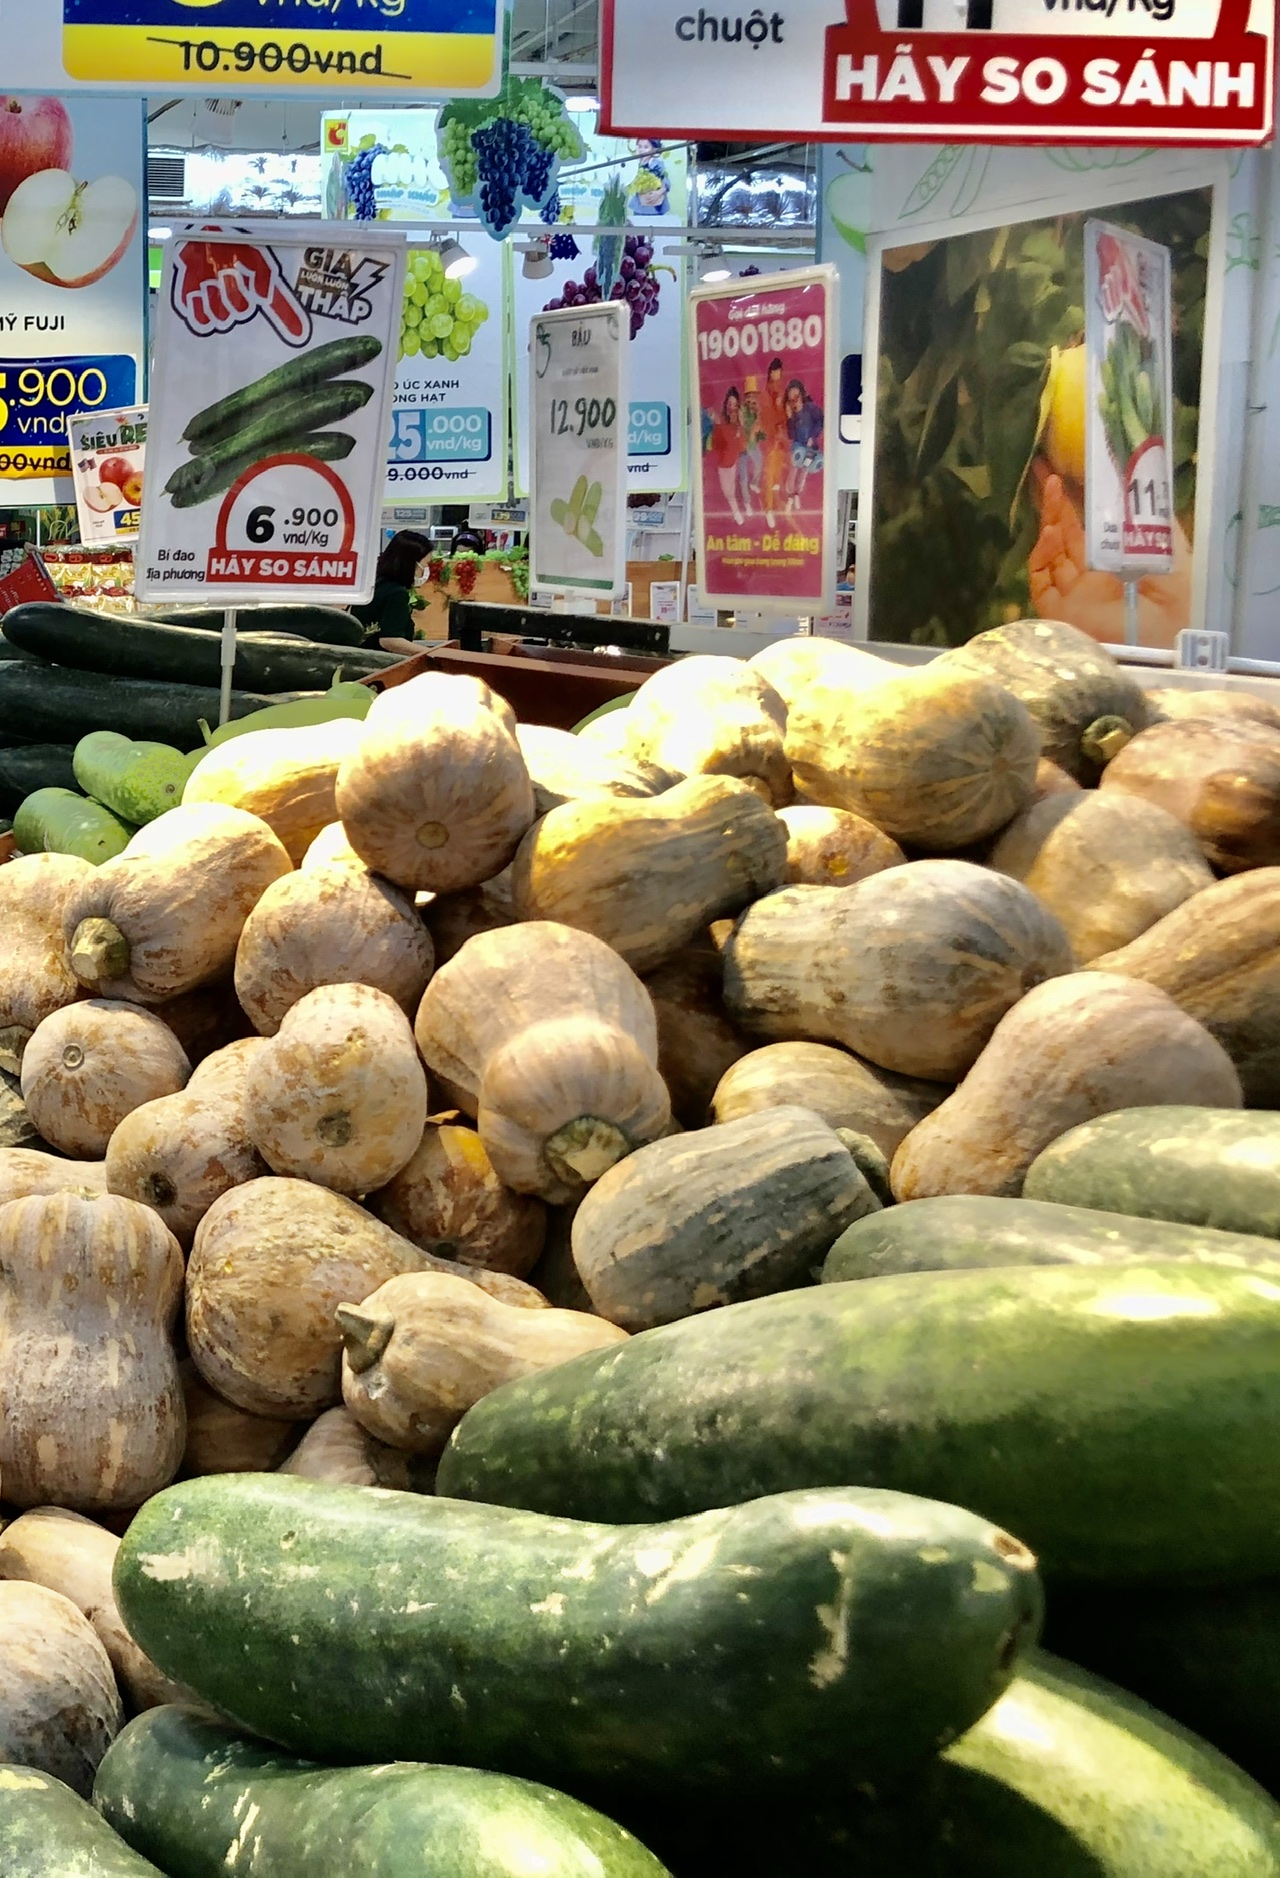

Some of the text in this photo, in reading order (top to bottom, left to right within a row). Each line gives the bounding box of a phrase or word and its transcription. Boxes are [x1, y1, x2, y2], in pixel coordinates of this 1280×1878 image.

[675, 9, 784, 51] chuột
[179, 42, 382, 75] 10.900vnd
[835, 43, 1255, 108] HÃY SO SÁNH
[301, 270, 350, 291] LUÔN LUÔN
[23, 315, 65, 331] FUJI
[698, 314, 823, 361] 19001880
[403, 378, 460, 390] ÚC XANH
[420, 392, 447, 405] HẠT
[17, 409, 80, 434] vnd/
[549, 397, 617, 437] 12.900
[80, 431, 118, 452] SIÊU
[426, 435, 482, 452] vnd/kg
[245, 506, 275, 544] 6
[283, 529, 329, 547] vnd/Kg
[706, 534, 724, 551] An
[726, 533, 752, 552] tâm
[157, 549, 195, 561] Bí đao
[210, 554, 354, 579] HÃY SO SÁNH
